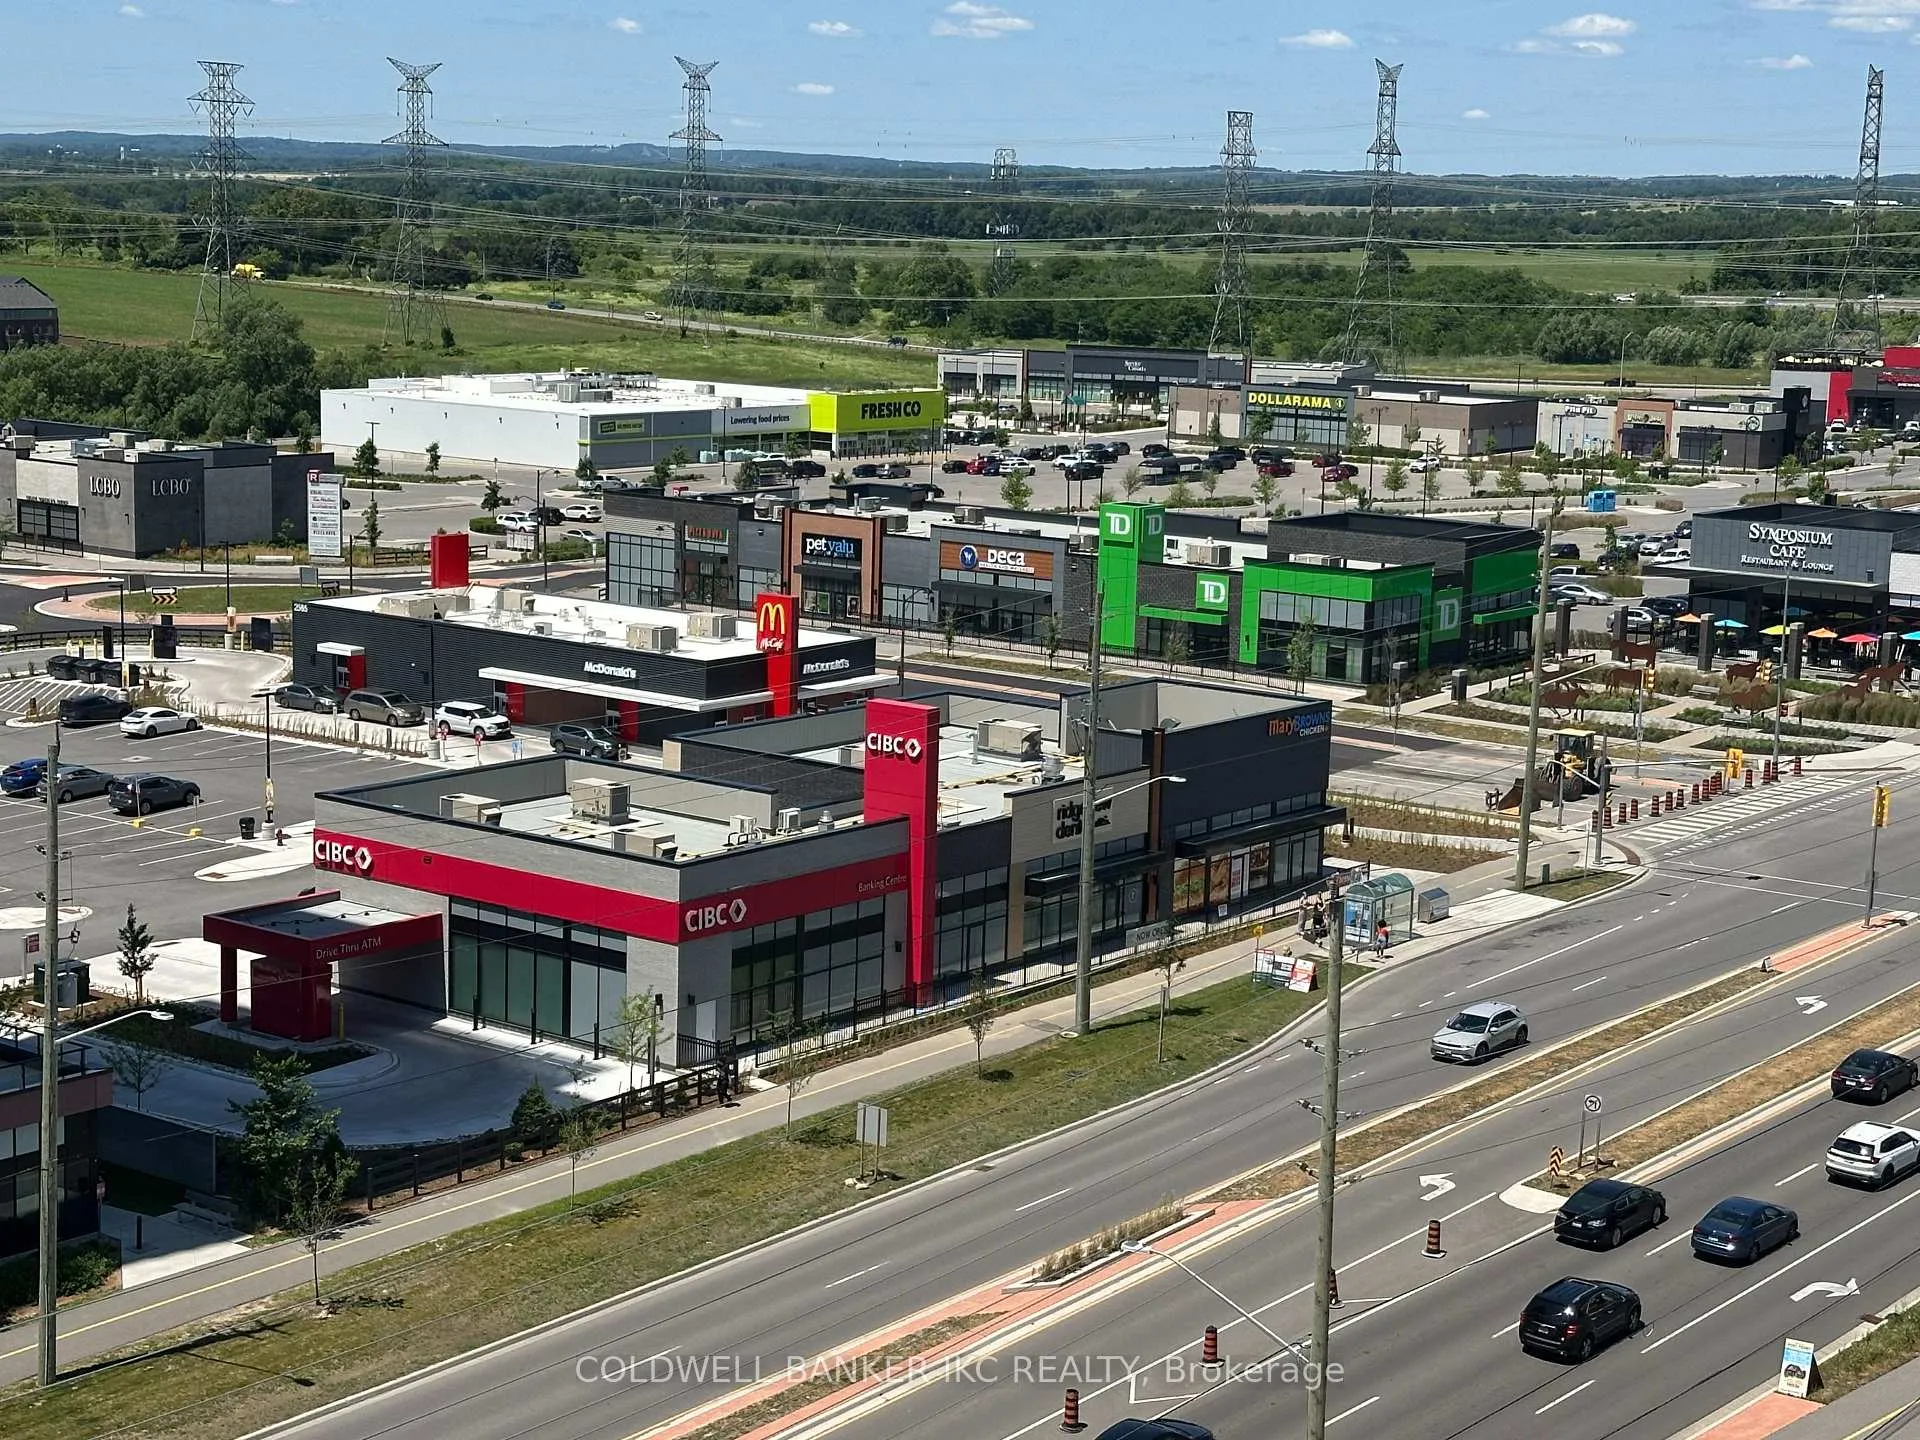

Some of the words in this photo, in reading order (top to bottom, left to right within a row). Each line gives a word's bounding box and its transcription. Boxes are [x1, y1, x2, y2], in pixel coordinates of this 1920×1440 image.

[1248, 392, 1332, 409] DOLLARAMA
[730, 415, 757, 425] Lowering
[758, 413, 772, 423] food
[773, 413, 790, 424] prices
[89, 475, 120, 496] LCBO
[152, 478, 190, 496] LCBO
[1105, 512, 1131, 535] TD
[1145, 514, 1163, 536] TD
[806, 537, 827, 553] pet
[828, 539, 854, 554] valu
[1769, 544, 1806, 559] CAFE
[1199, 580, 1226, 604] TD
[1436, 598, 1459, 631] TD
[584, 661, 637, 679] McDonald's
[803, 658, 850, 674] McDonald's
[867, 733, 904, 754] CIBC
[315, 839, 355, 866] CIBC
[858, 880, 885, 893] Banking
[685, 903, 727, 932] CIBC
[316, 948, 338, 960] Drive
[340, 943, 360, 954] Thru
[361, 936, 381, 950] ATM
